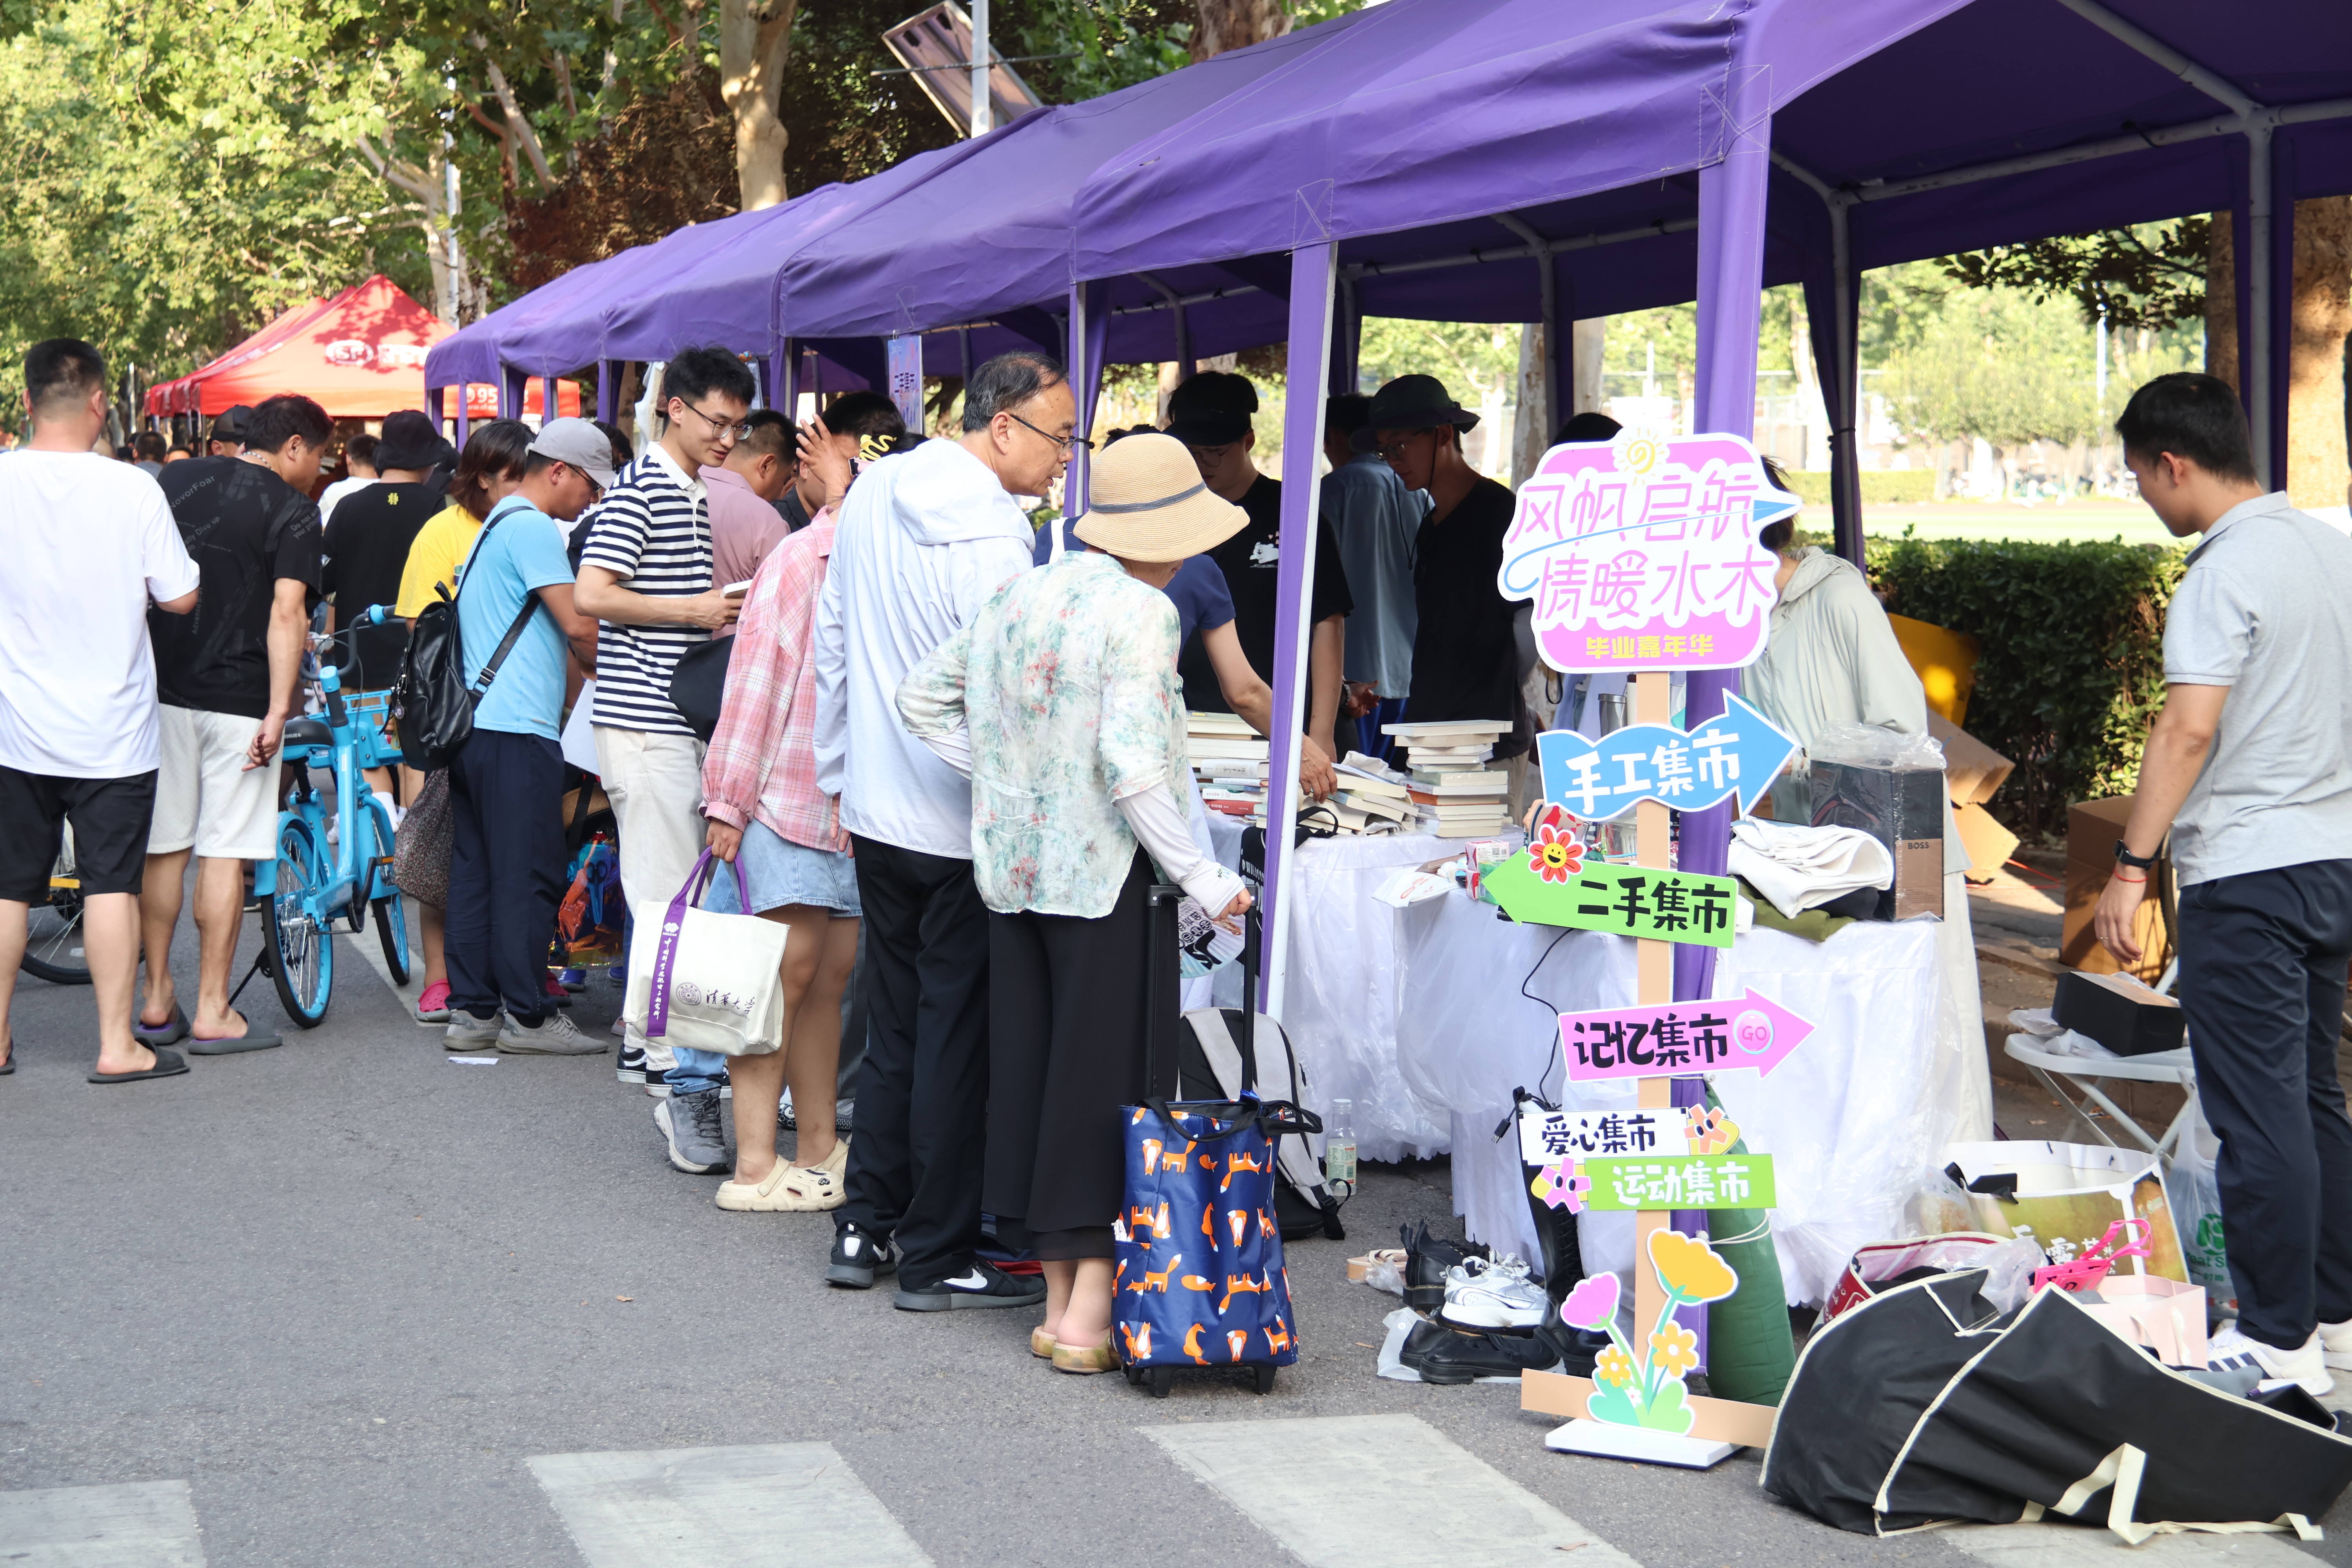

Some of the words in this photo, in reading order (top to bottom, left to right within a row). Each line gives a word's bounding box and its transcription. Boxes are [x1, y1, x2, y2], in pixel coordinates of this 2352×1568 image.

[894, 370, 915, 393] 二手集市
[1509, 470, 1759, 547] 风帆启航
[1536, 543, 1774, 621] 情暖水木
[1586, 634, 1714, 659] 毕业嘉年华
[1564, 728, 1740, 815] 手工集市
[1577, 877, 1730, 934] 二手集市
[1573, 1012, 1728, 1069] 记忆集市
[1742, 1025, 1766, 1041] GO
[1542, 1113, 1656, 1155] 爱心集市
[1612, 1160, 1750, 1206] 运动集市
